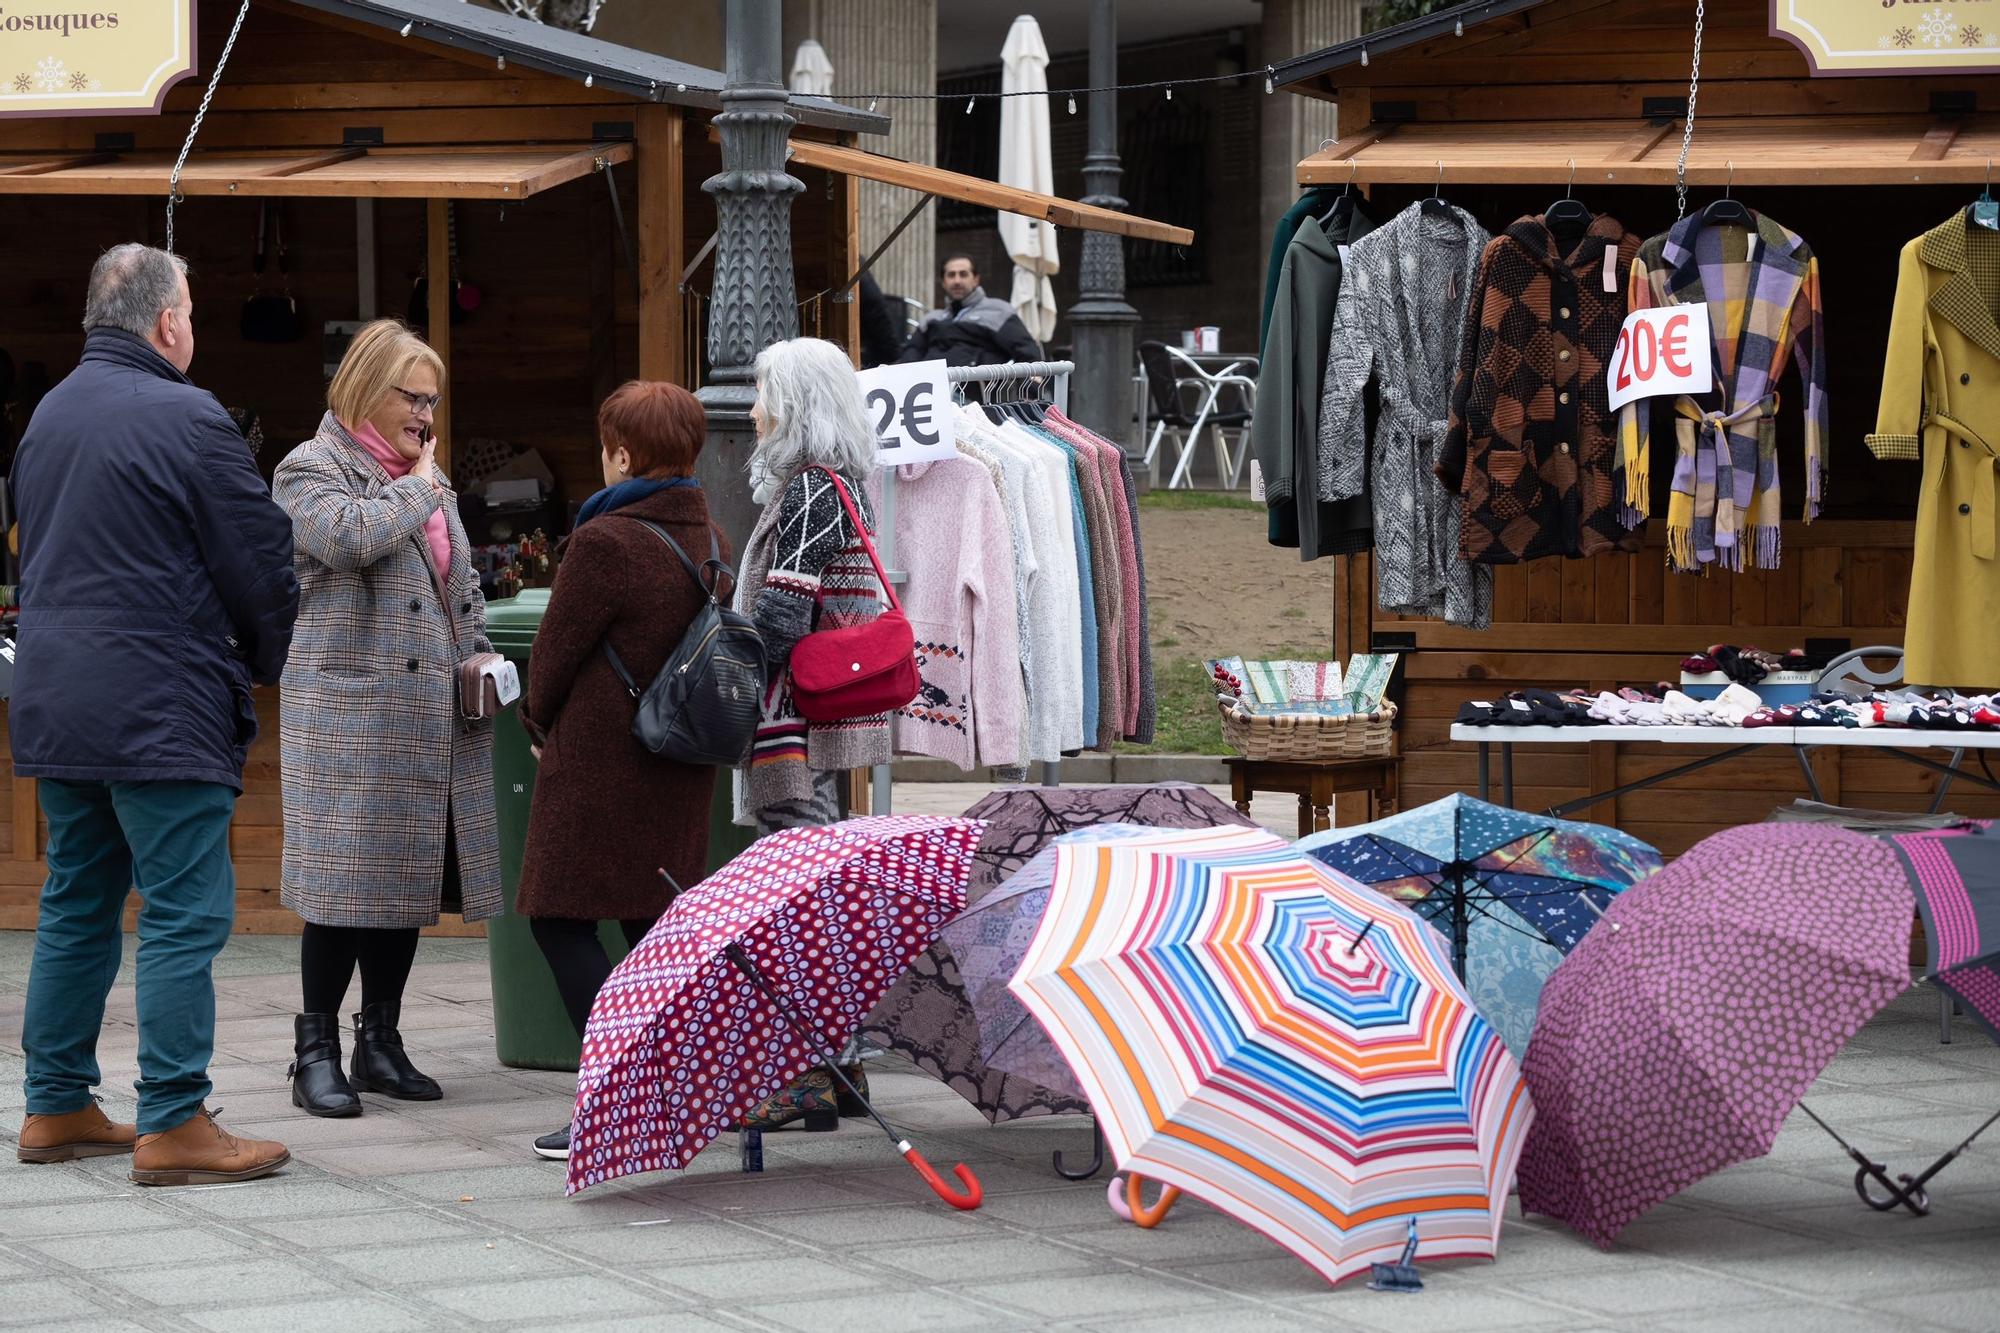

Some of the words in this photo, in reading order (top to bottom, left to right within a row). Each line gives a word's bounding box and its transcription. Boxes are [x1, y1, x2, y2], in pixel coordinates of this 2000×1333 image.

[0, 7, 119, 37] osuques
[1616, 314, 1692, 392] 20€
[866, 382, 940, 450] 2€
